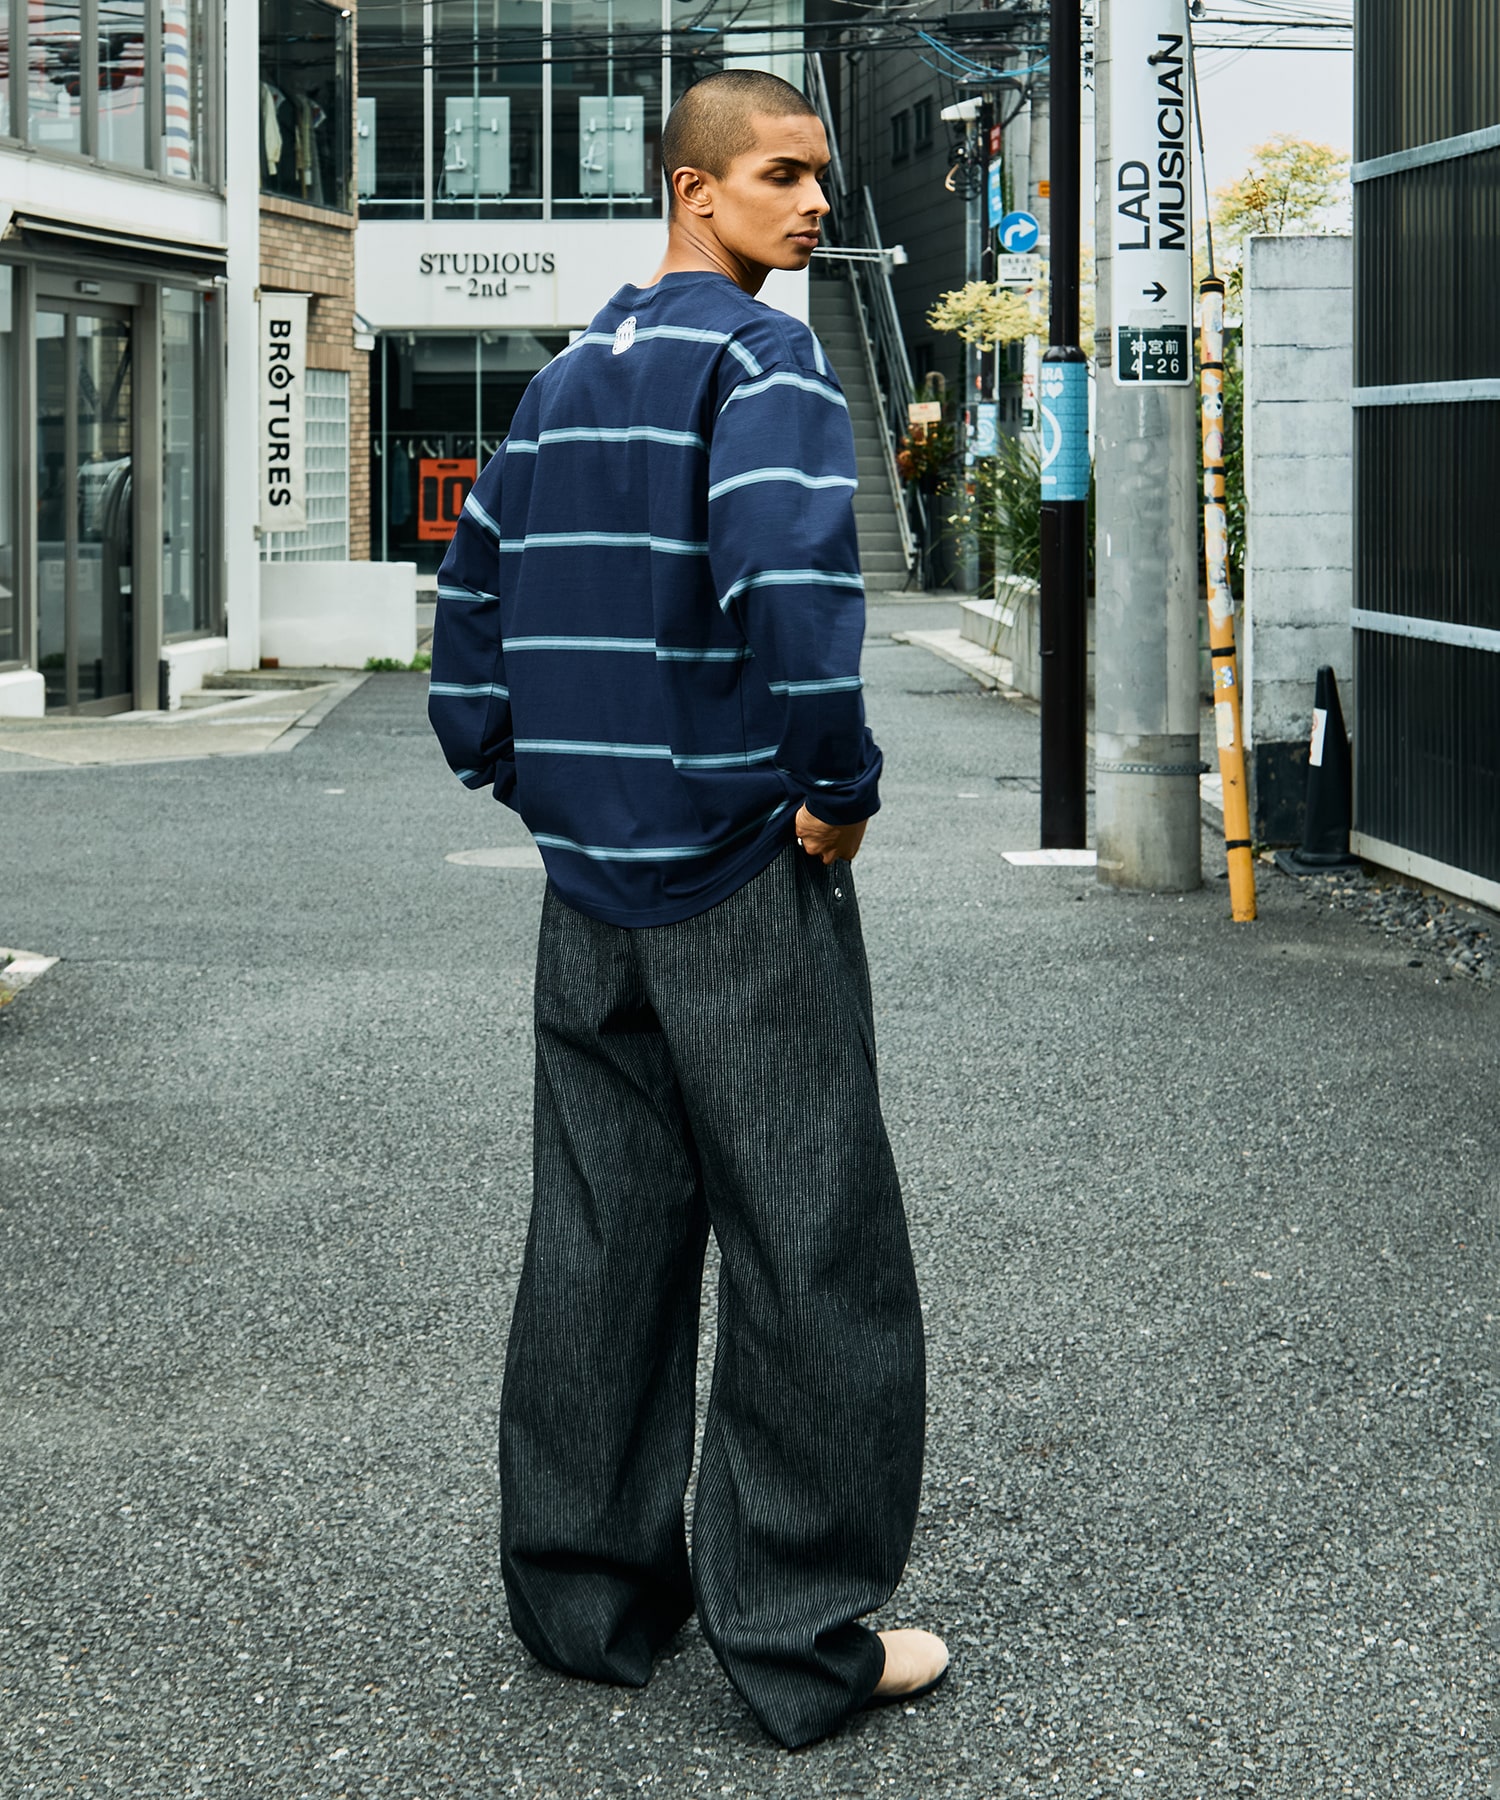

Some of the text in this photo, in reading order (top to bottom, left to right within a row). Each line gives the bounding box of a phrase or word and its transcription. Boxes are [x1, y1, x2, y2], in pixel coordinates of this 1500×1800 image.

[1157, 33, 1186, 251] MUSICIAN
[1118, 160, 1150, 251] LAD
[420, 253, 555, 275] STUDIOUS
[468, 278, 507, 297] 2nd
[1130, 339, 1179, 355] 神宮前
[1131, 358, 1180, 374] 4-26
[268, 320, 295, 506] BROTURES
